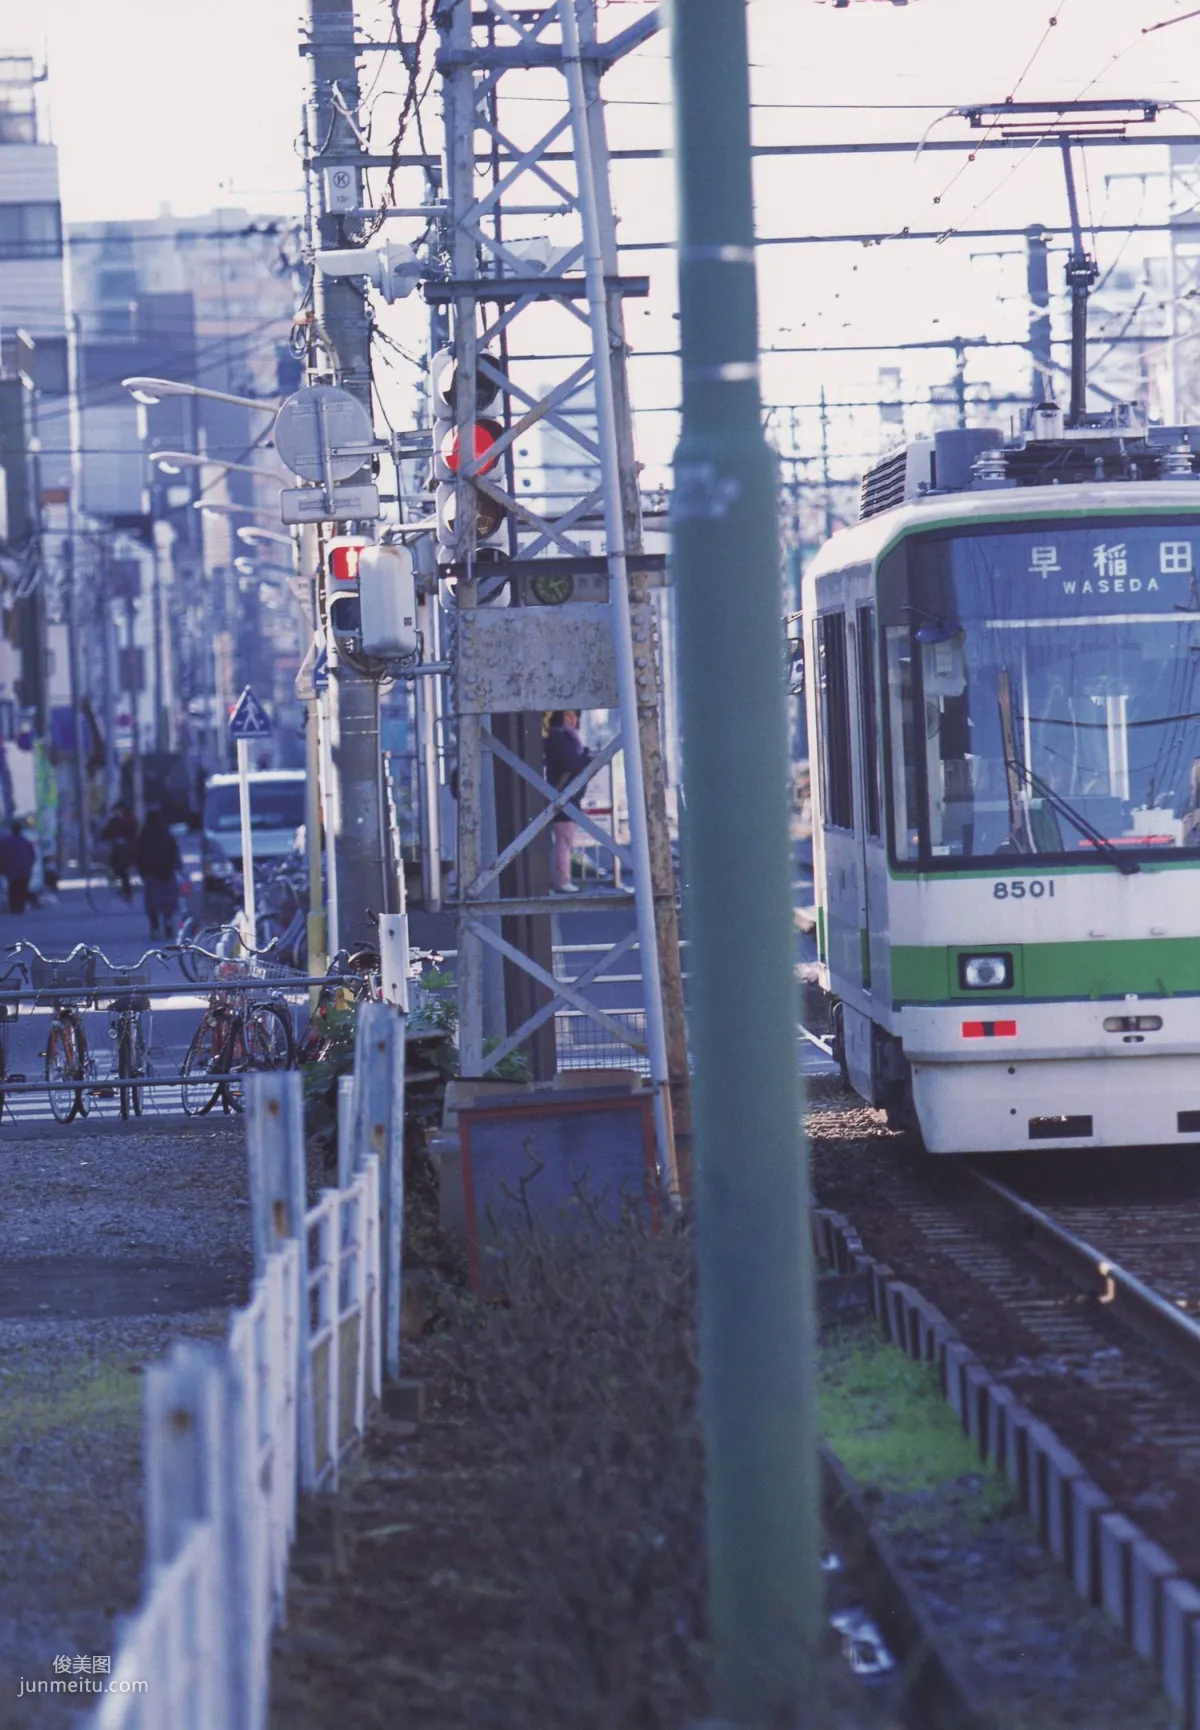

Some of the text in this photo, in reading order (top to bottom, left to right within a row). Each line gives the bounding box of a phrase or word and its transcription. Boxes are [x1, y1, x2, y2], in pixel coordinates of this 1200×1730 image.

[1028, 541, 1193, 579] 早稲田
[1063, 577, 1159, 594] WASEDA
[993, 880, 1054, 900] 8501
